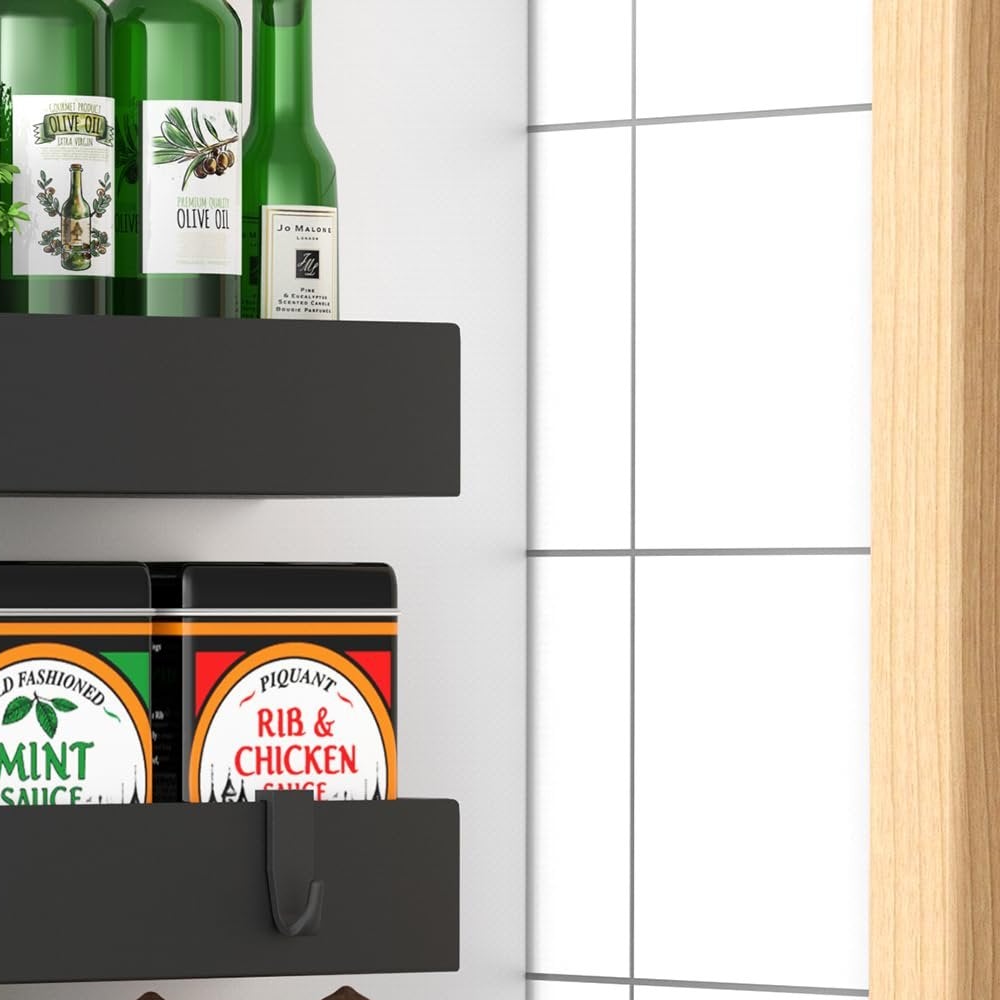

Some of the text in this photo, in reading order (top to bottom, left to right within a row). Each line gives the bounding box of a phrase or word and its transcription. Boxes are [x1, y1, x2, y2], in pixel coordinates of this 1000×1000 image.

[48, 114, 100, 134] OLIVE OIL
[57, 137, 94, 146] EXTRA VIRGIN
[176, 196, 207, 208] PREMIUM
[177, 208, 230, 230] OLIVE OIL
[18, 668, 106, 706] FASHIONED
[259, 668, 337, 693] PIQUANT
[257, 706, 336, 738] RIB &
[234, 744, 359, 777] CHICKEN
